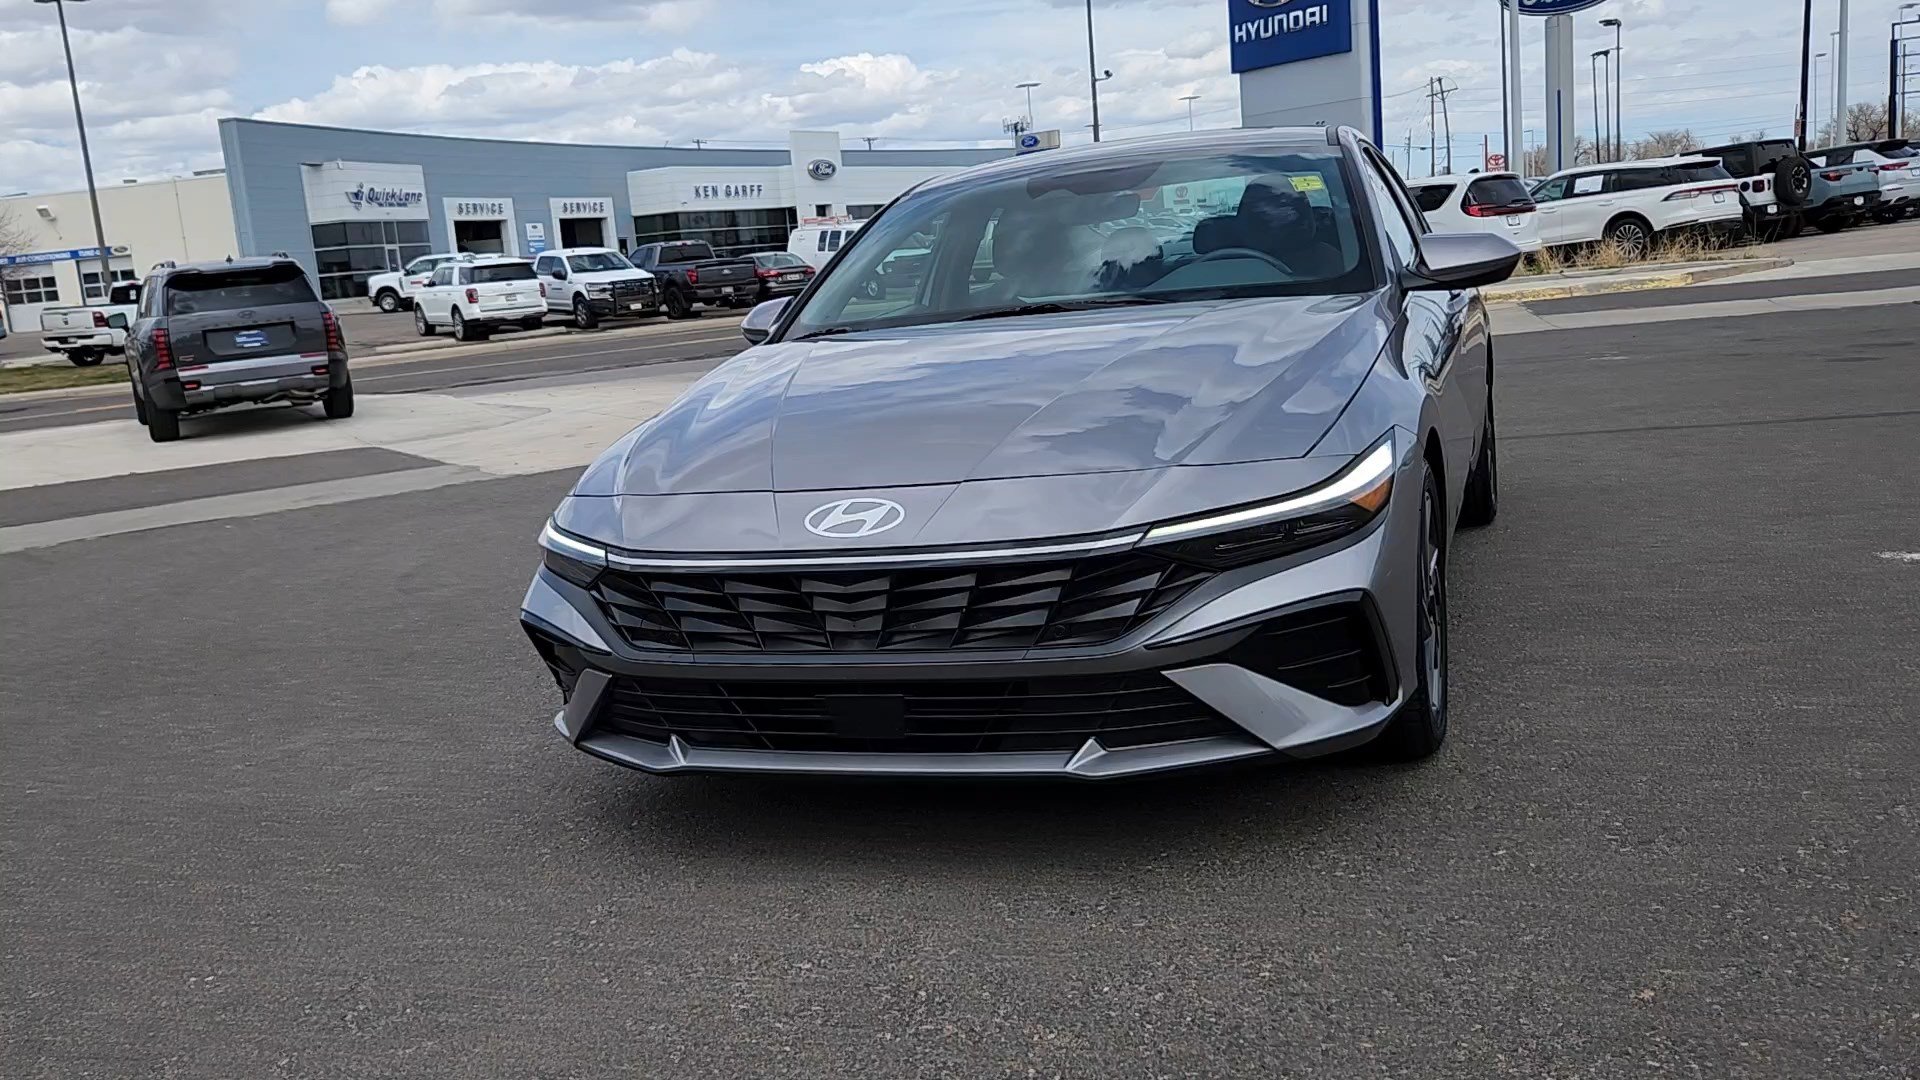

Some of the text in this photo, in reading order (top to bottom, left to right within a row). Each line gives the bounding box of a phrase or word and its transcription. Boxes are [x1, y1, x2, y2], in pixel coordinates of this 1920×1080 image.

[1234, 4, 1328, 43] HYUNDAI
[817, 163, 833, 176] Ford
[367, 187, 423, 203] Quick Lane
[694, 184, 763, 198] KEN GARFF
[457, 202, 504, 216] SERVICE
[562, 201, 605, 214] SERVICE
